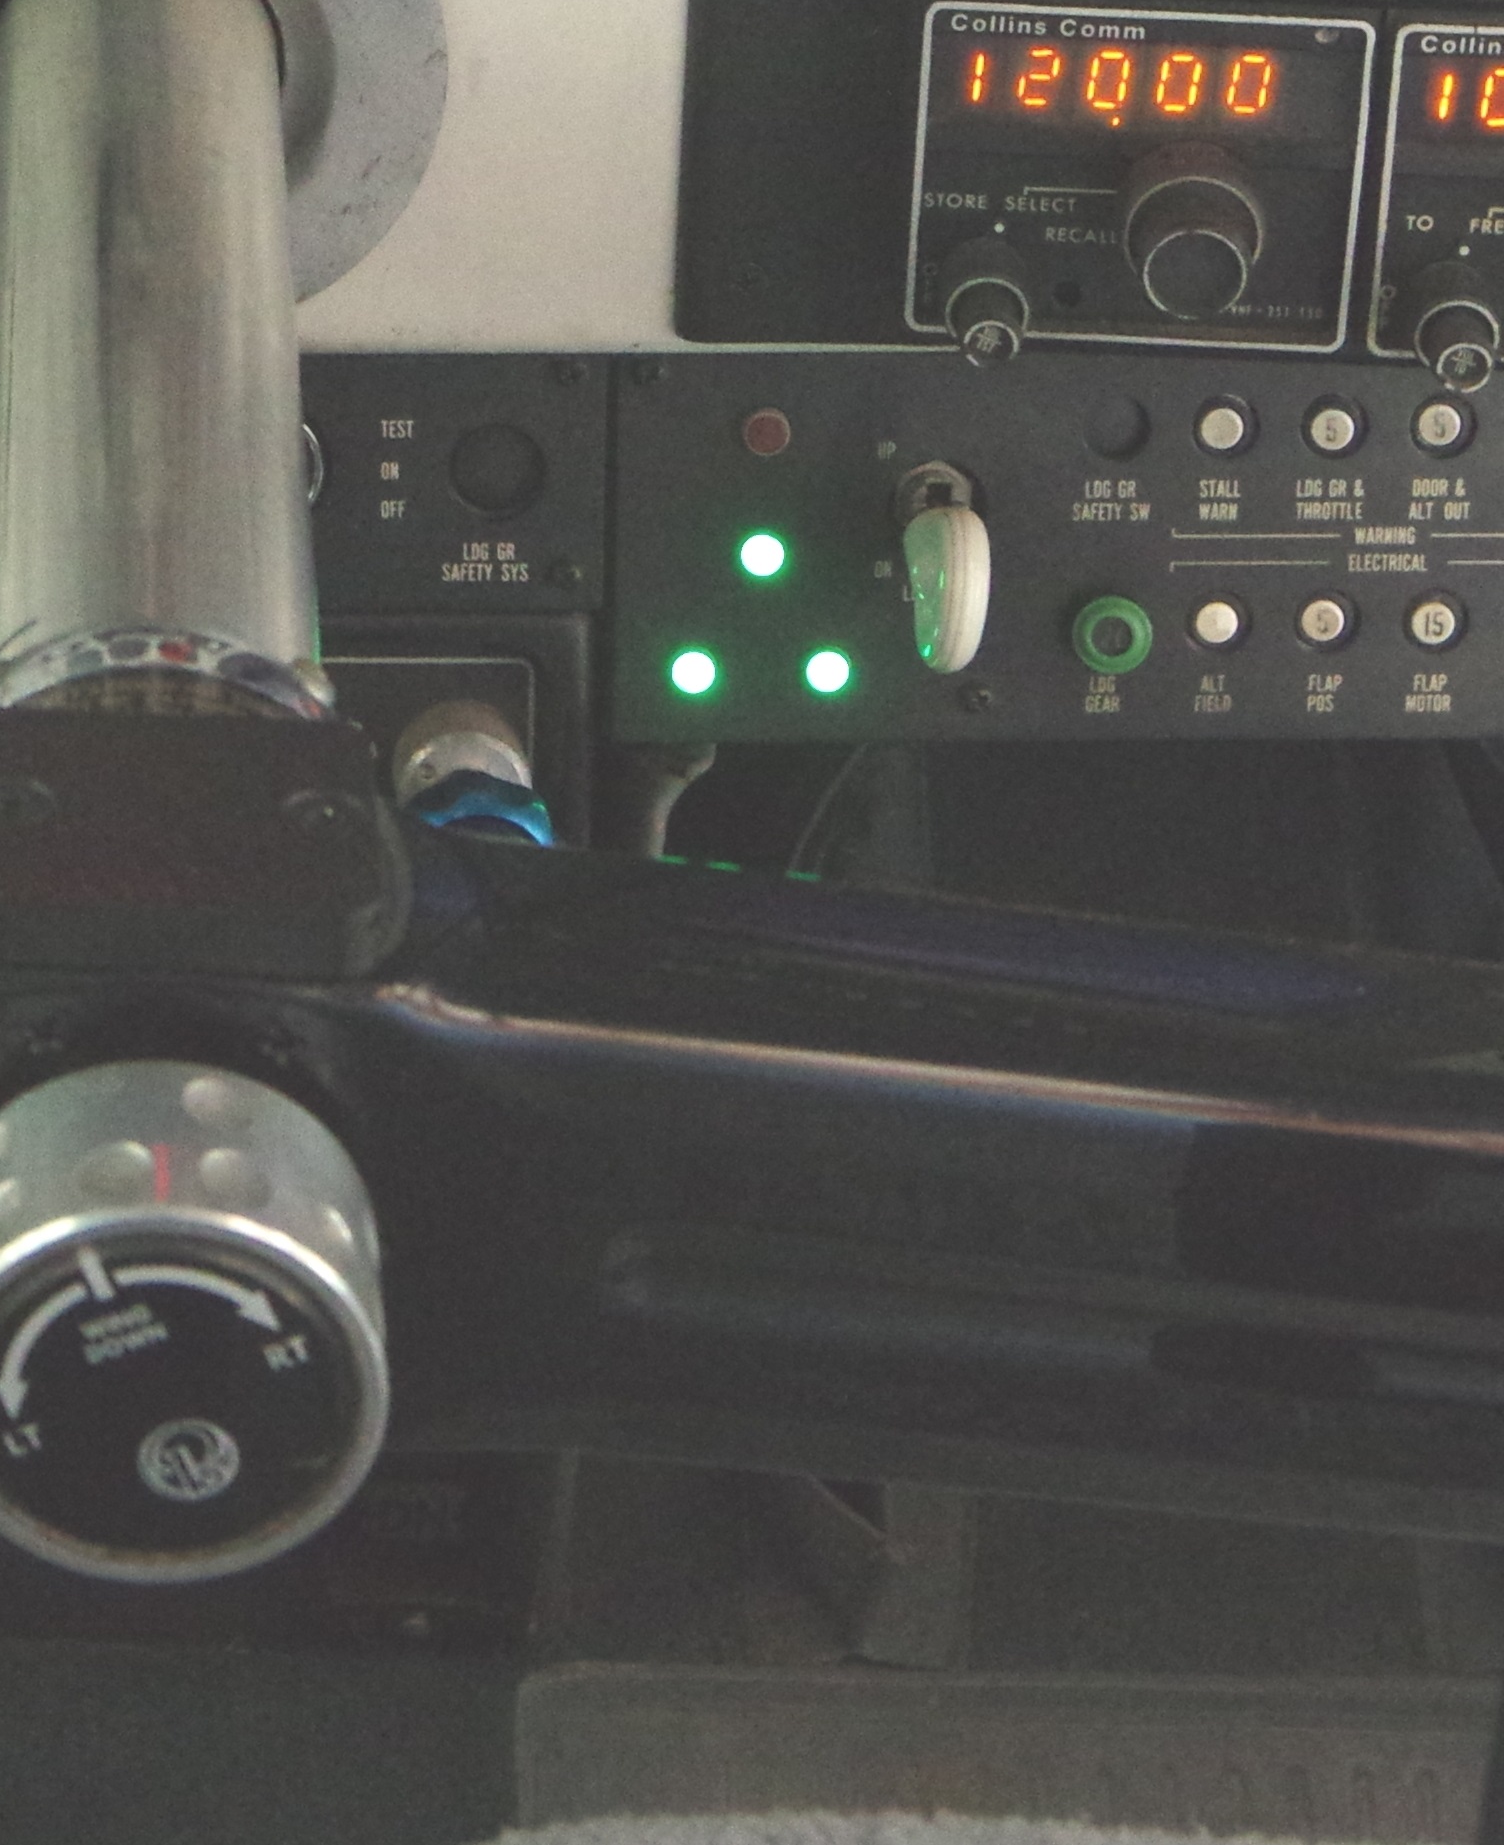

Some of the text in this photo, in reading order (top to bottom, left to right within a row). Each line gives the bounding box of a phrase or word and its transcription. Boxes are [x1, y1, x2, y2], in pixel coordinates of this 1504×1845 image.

[951, 14, 1145, 39] Collins Comm
[924, 192, 1076, 212] STORE SELECT
[1406, 215, 1434, 232] TO
[1045, 226, 1118, 244] RECALL
[381, 420, 413, 438] TEST
[1354, 527, 1417, 546] WARNING
[441, 563, 529, 582] SAFETY SYS
